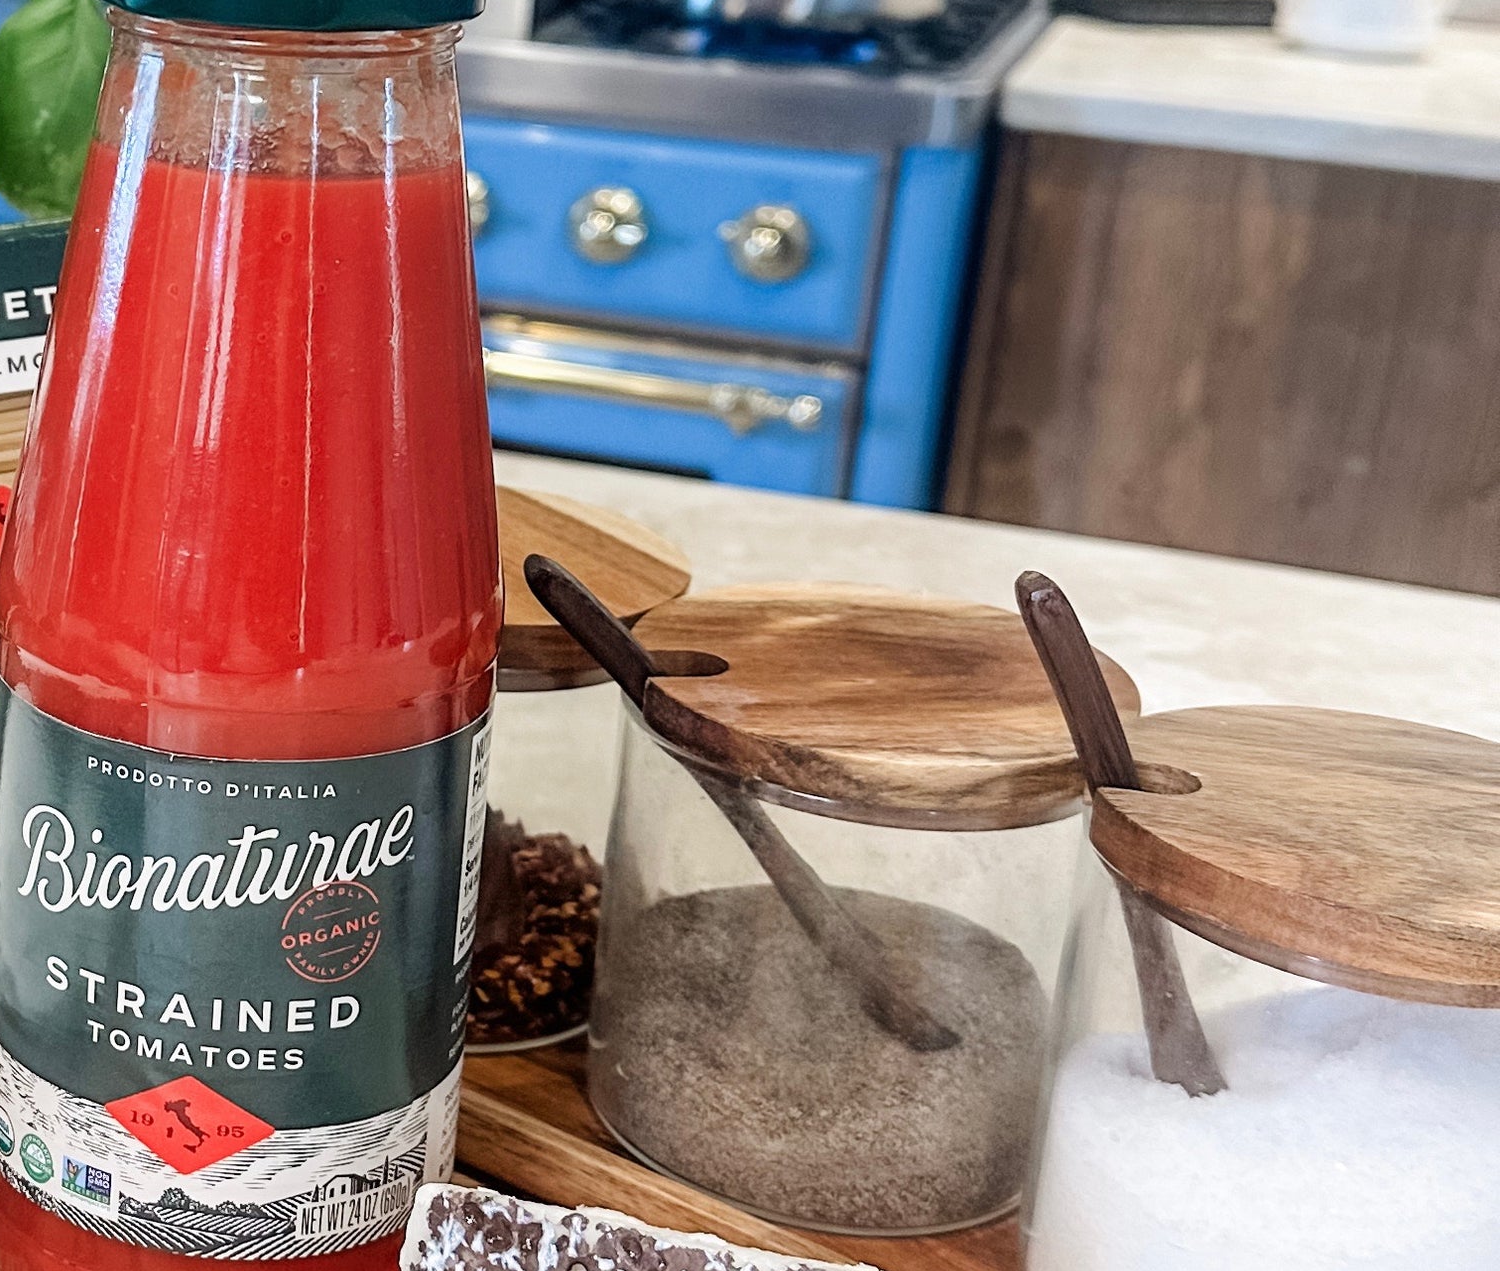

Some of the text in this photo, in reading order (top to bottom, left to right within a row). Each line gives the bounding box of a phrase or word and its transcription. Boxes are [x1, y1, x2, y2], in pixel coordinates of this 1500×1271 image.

[86, 756, 338, 799] PRODOTTO D'ITALIA
[18, 804, 414, 912] Bionaturae
[298, 887, 363, 915] PROUDLY
[281, 911, 380, 950] ORGANIC
[294, 931, 375, 976] FAMILY OWNED
[45, 956, 360, 1032] STRAINED
[87, 1020, 304, 1070] TOMATOES
[131, 1110, 245, 1139] 19 95
[301, 1205, 325, 1235] NET
[328, 1200, 347, 1231] WT
[348, 1197, 361, 1227] 24
[364, 1192, 378, 1222] OZ
